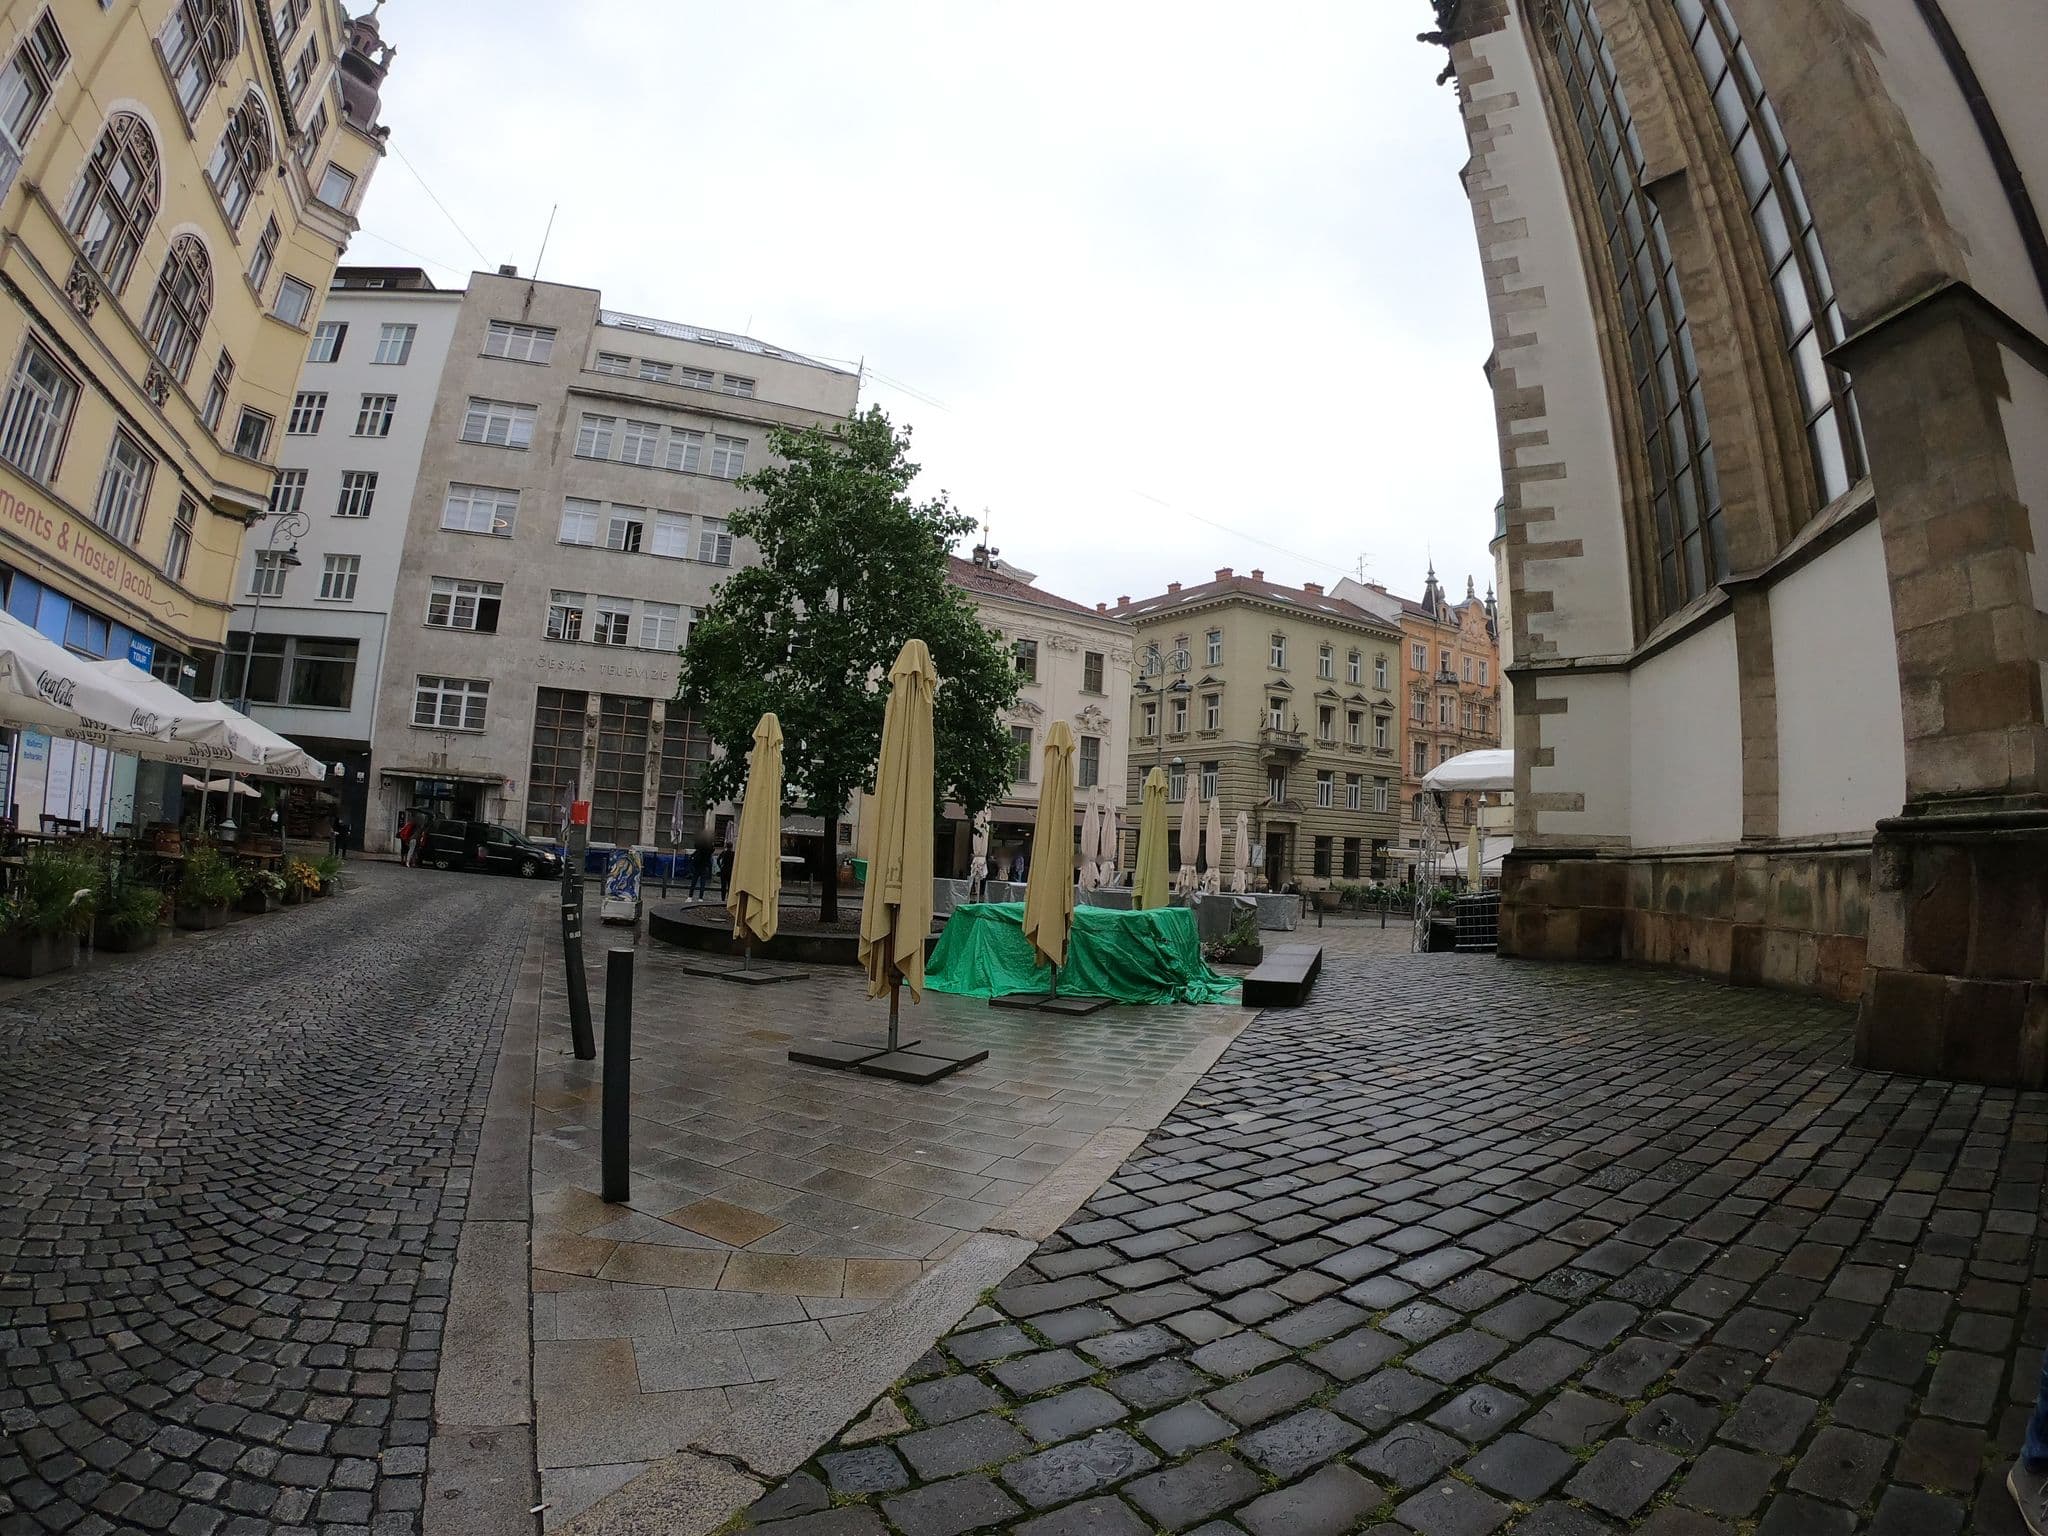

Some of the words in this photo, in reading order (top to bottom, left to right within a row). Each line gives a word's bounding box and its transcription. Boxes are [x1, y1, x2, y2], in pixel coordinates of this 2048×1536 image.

[0, 488, 53, 541] ments
[57, 521, 70, 552] &
[73, 531, 120, 581] Hostel
[118, 561, 152, 600] Jacob
[536, 654, 586, 673] ČESKÁ
[600, 663, 669, 681] TELEVIZE
